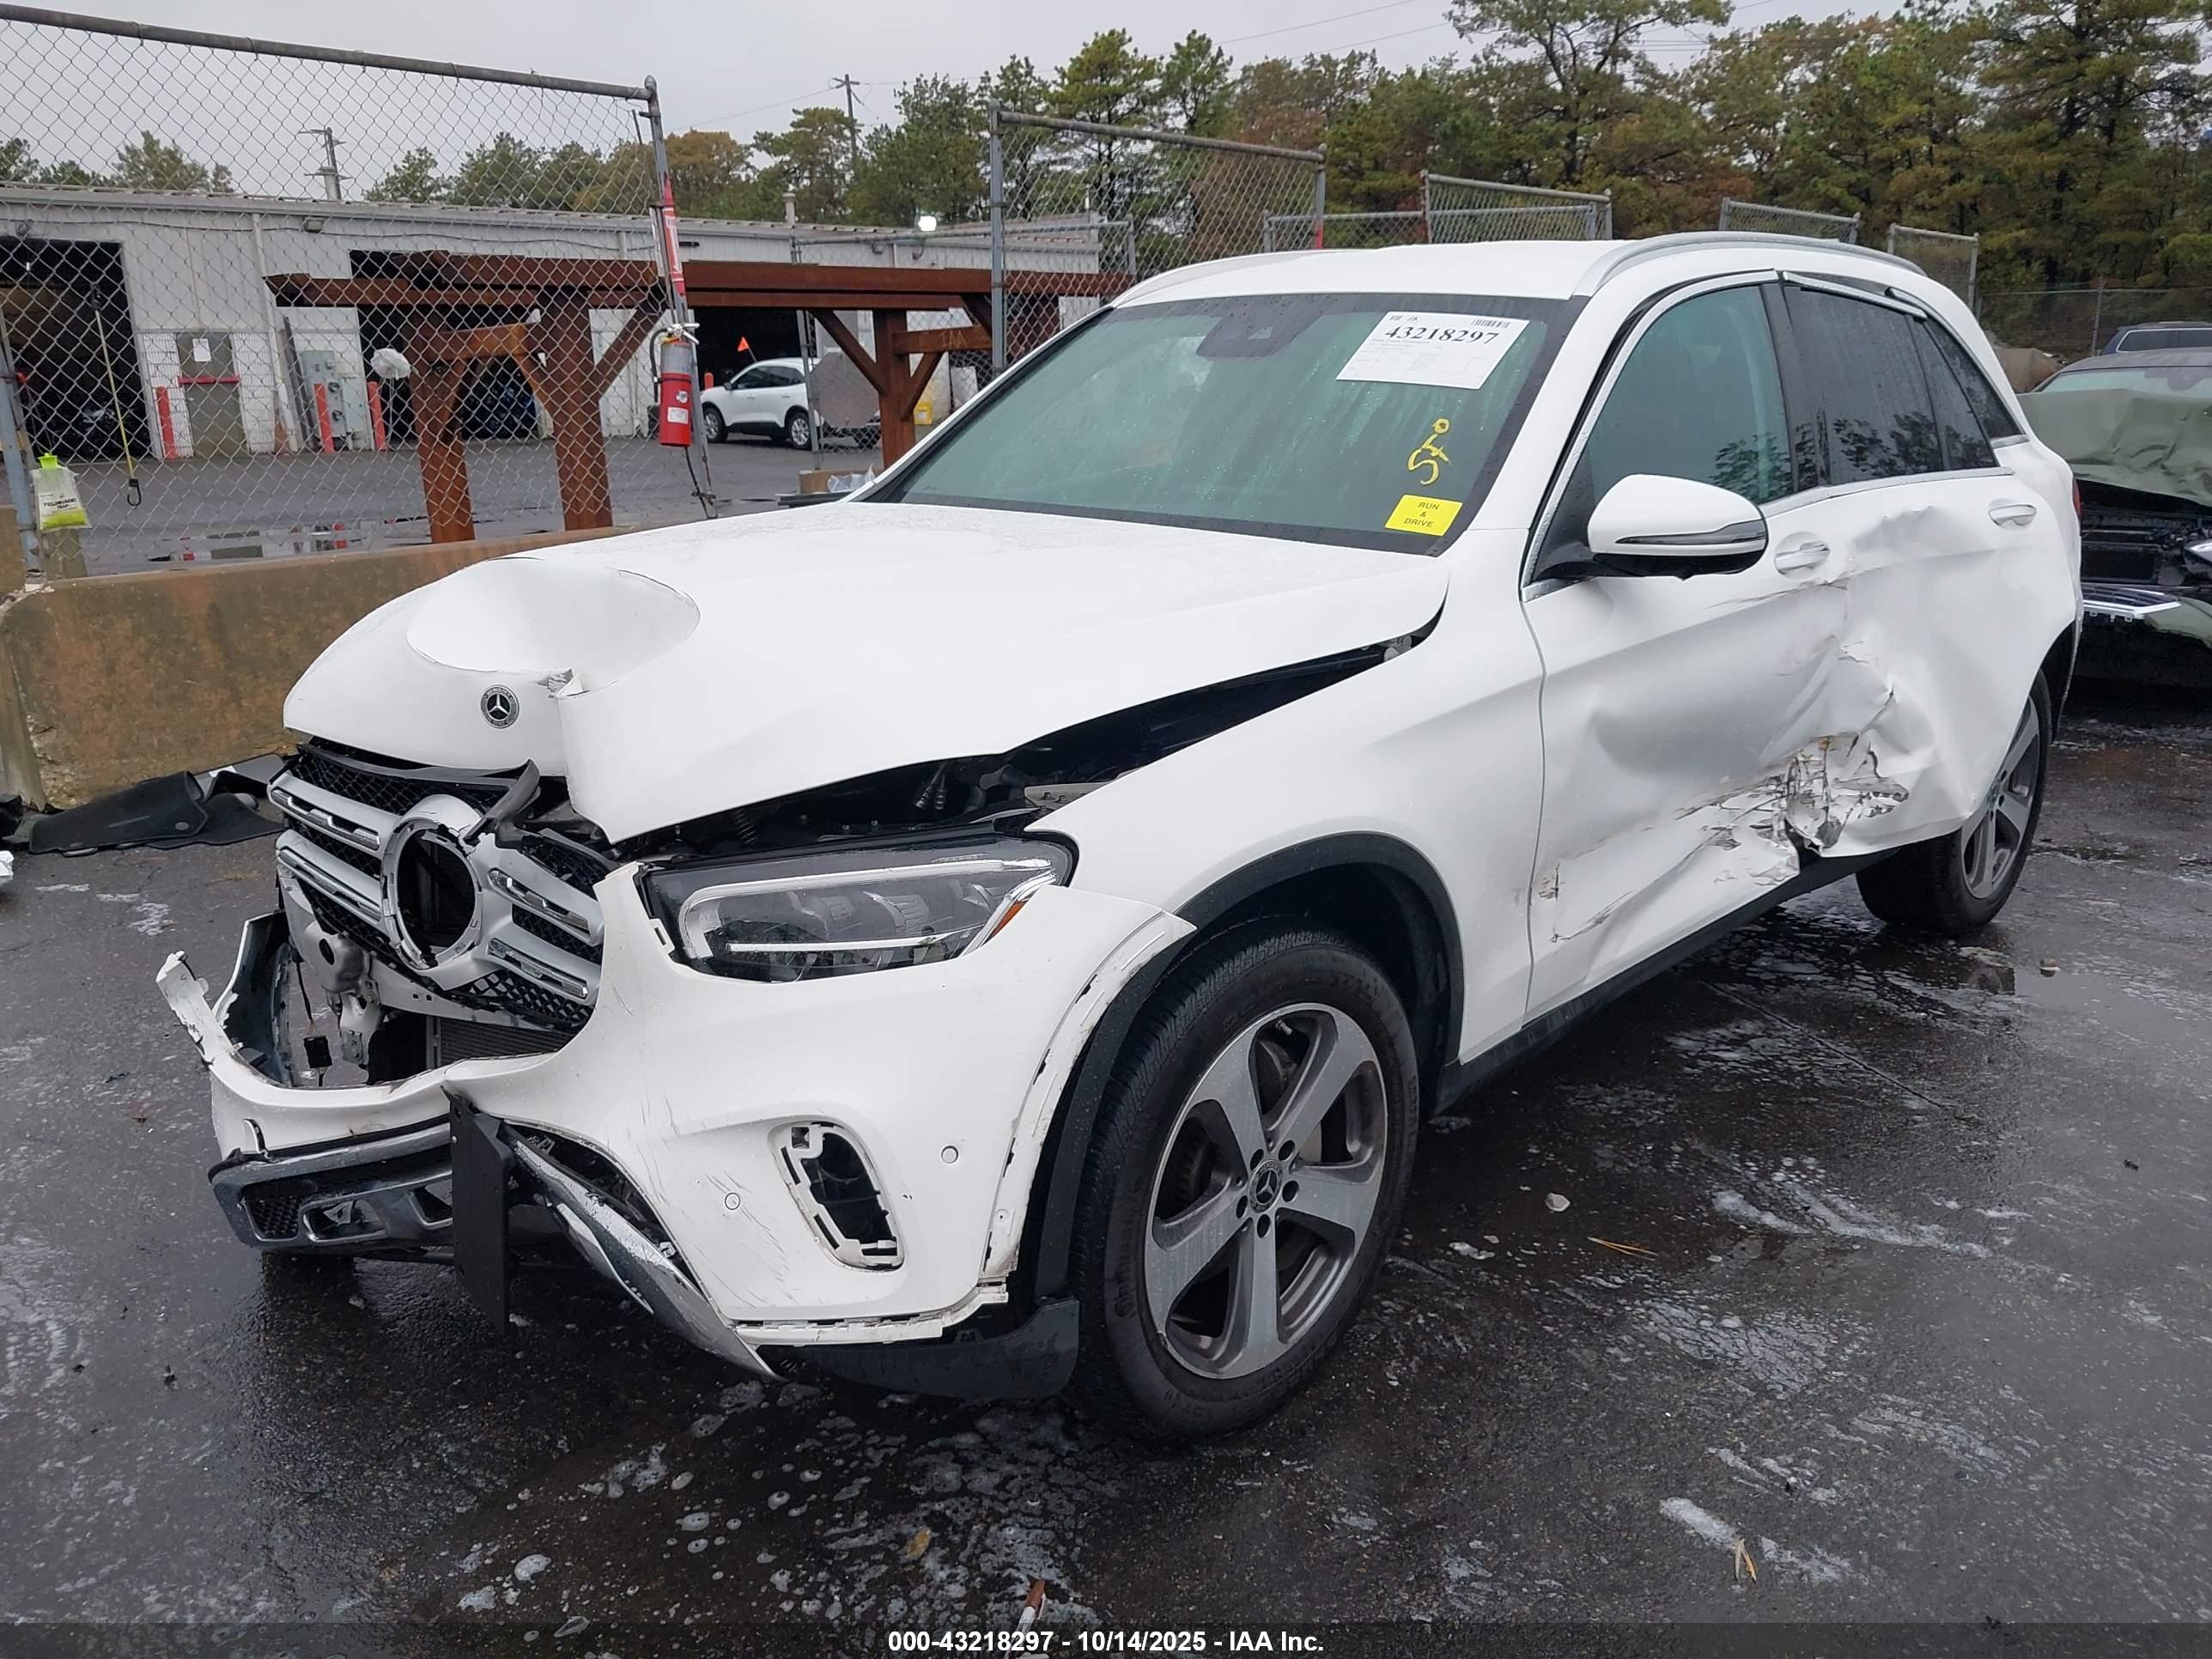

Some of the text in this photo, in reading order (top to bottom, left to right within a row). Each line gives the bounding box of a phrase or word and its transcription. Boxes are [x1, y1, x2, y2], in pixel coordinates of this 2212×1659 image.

[1385, 325, 1499, 343] 43218297
[1418, 501, 1440, 510] RUN
[1403, 518, 1435, 527] DRIVE
